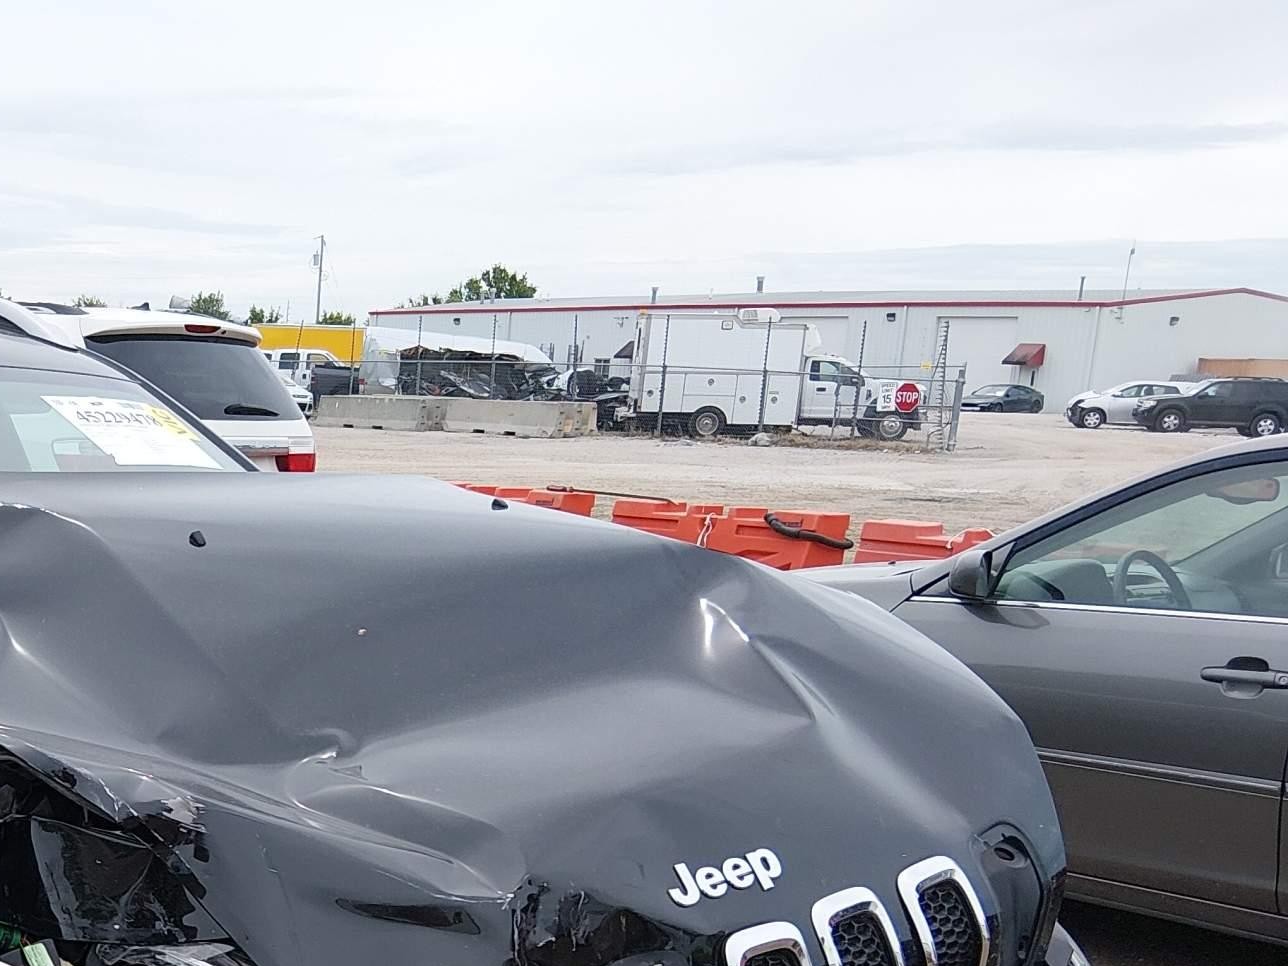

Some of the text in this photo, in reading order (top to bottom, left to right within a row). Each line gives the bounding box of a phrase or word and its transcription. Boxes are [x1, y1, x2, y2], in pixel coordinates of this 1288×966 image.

[882, 394, 892, 404] 15
[896, 391, 919, 403] STOP
[668, 848, 782, 907] Jeep
